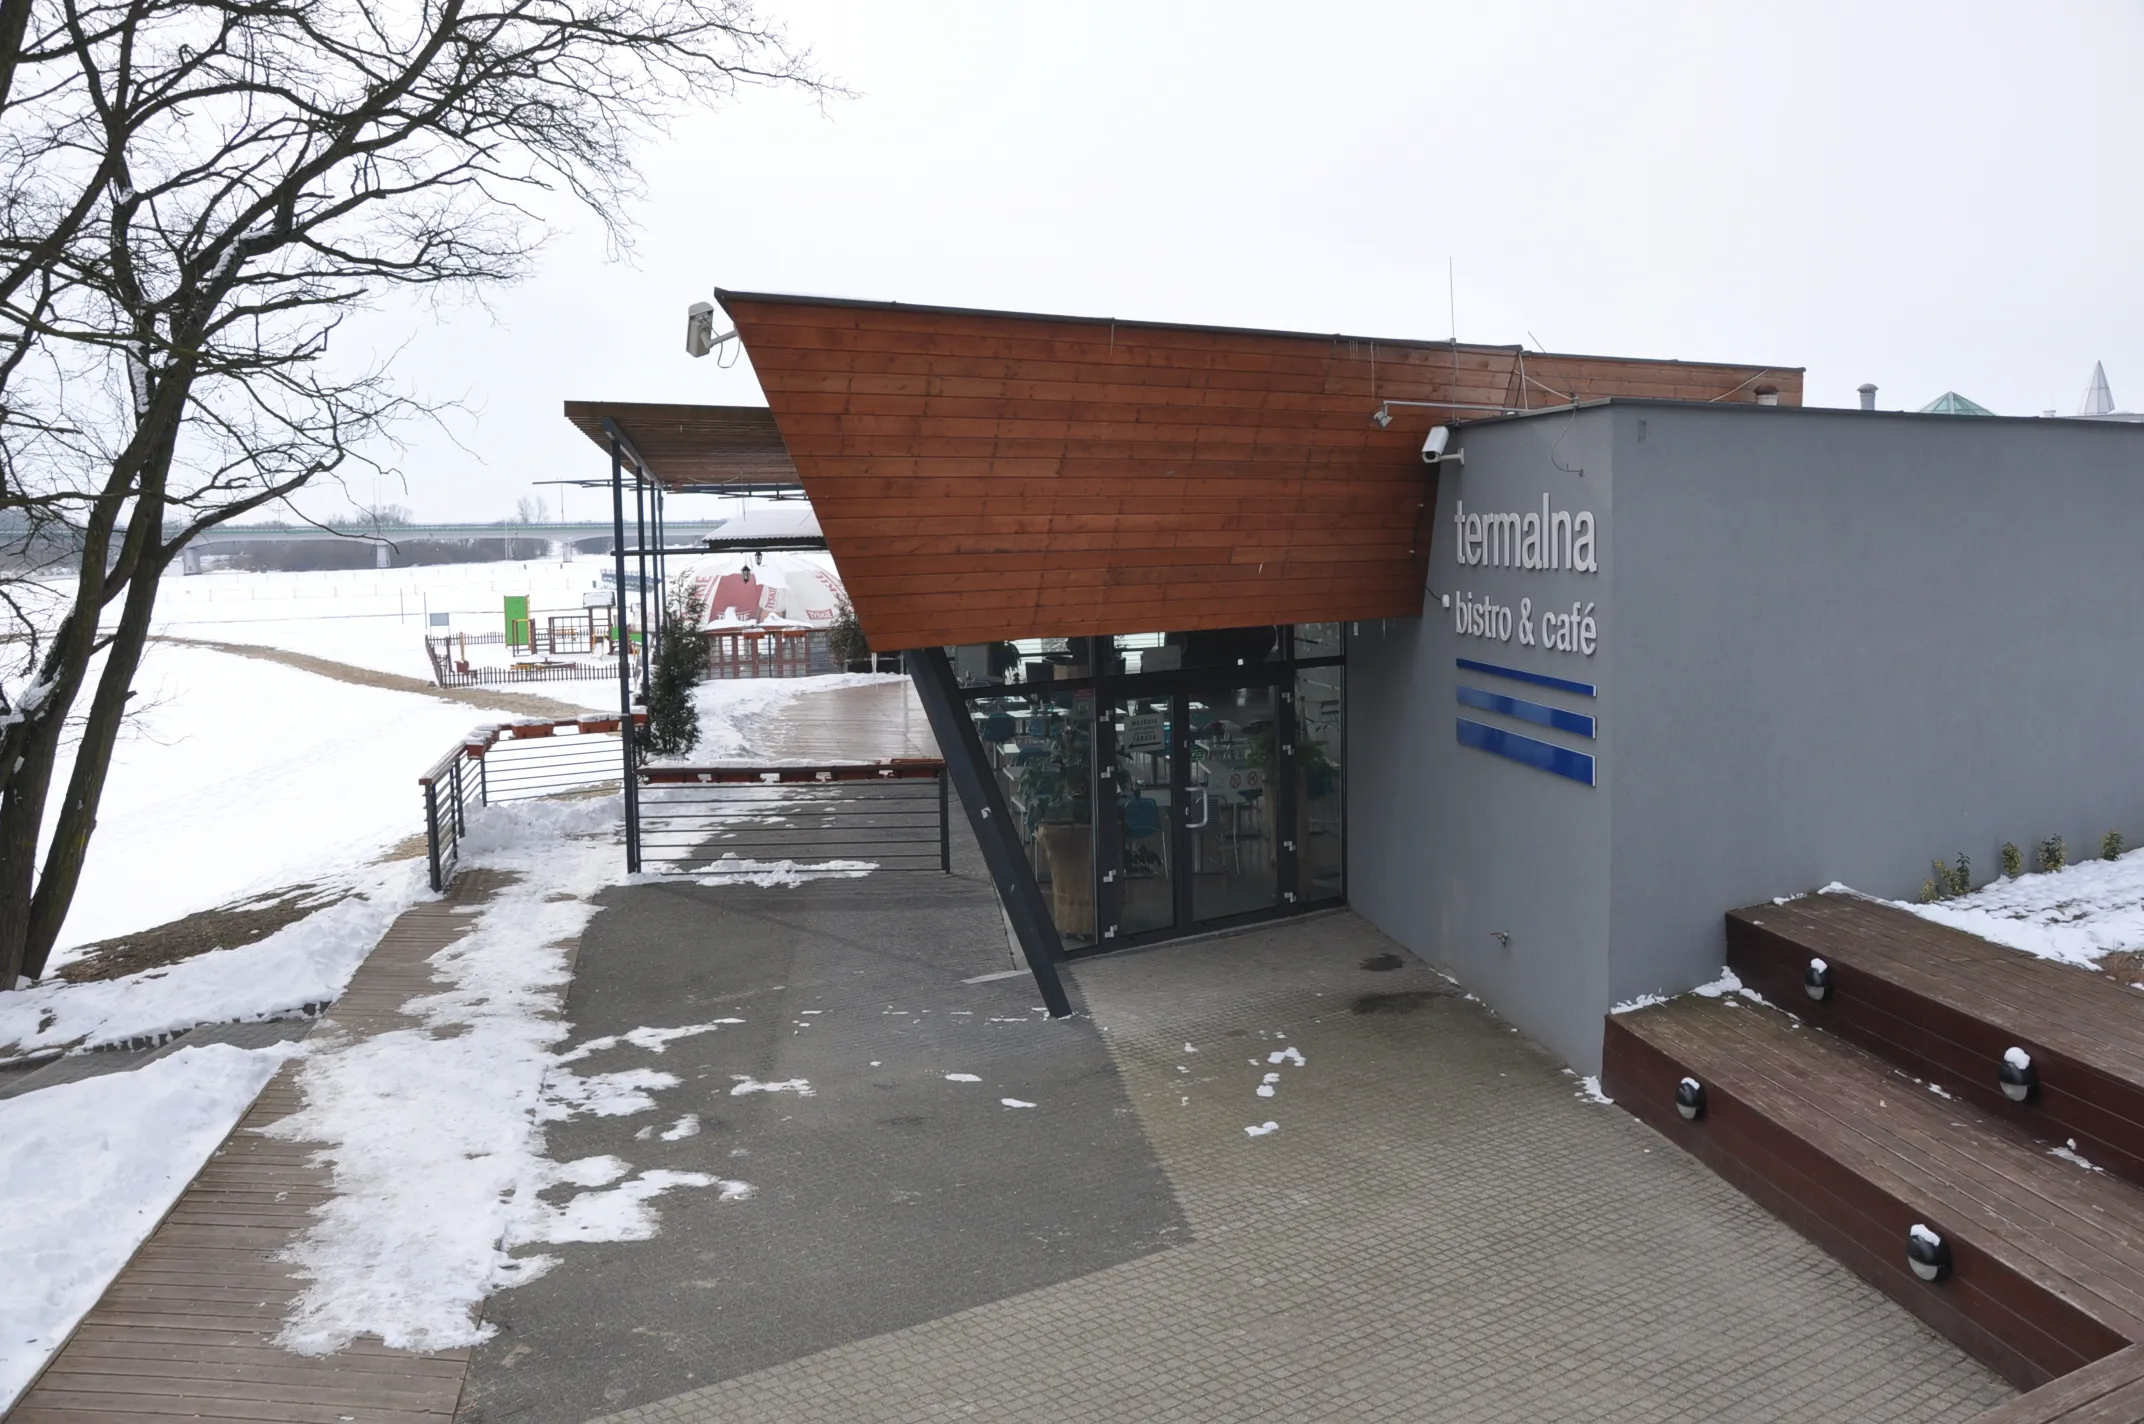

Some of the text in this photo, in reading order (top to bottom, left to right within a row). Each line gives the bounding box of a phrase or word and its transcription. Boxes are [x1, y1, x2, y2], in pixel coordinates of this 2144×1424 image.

[1454, 492, 1598, 573] termalna
[808, 609, 834, 619] TYSKIE
[1455, 590, 1598, 656] bistro & café
